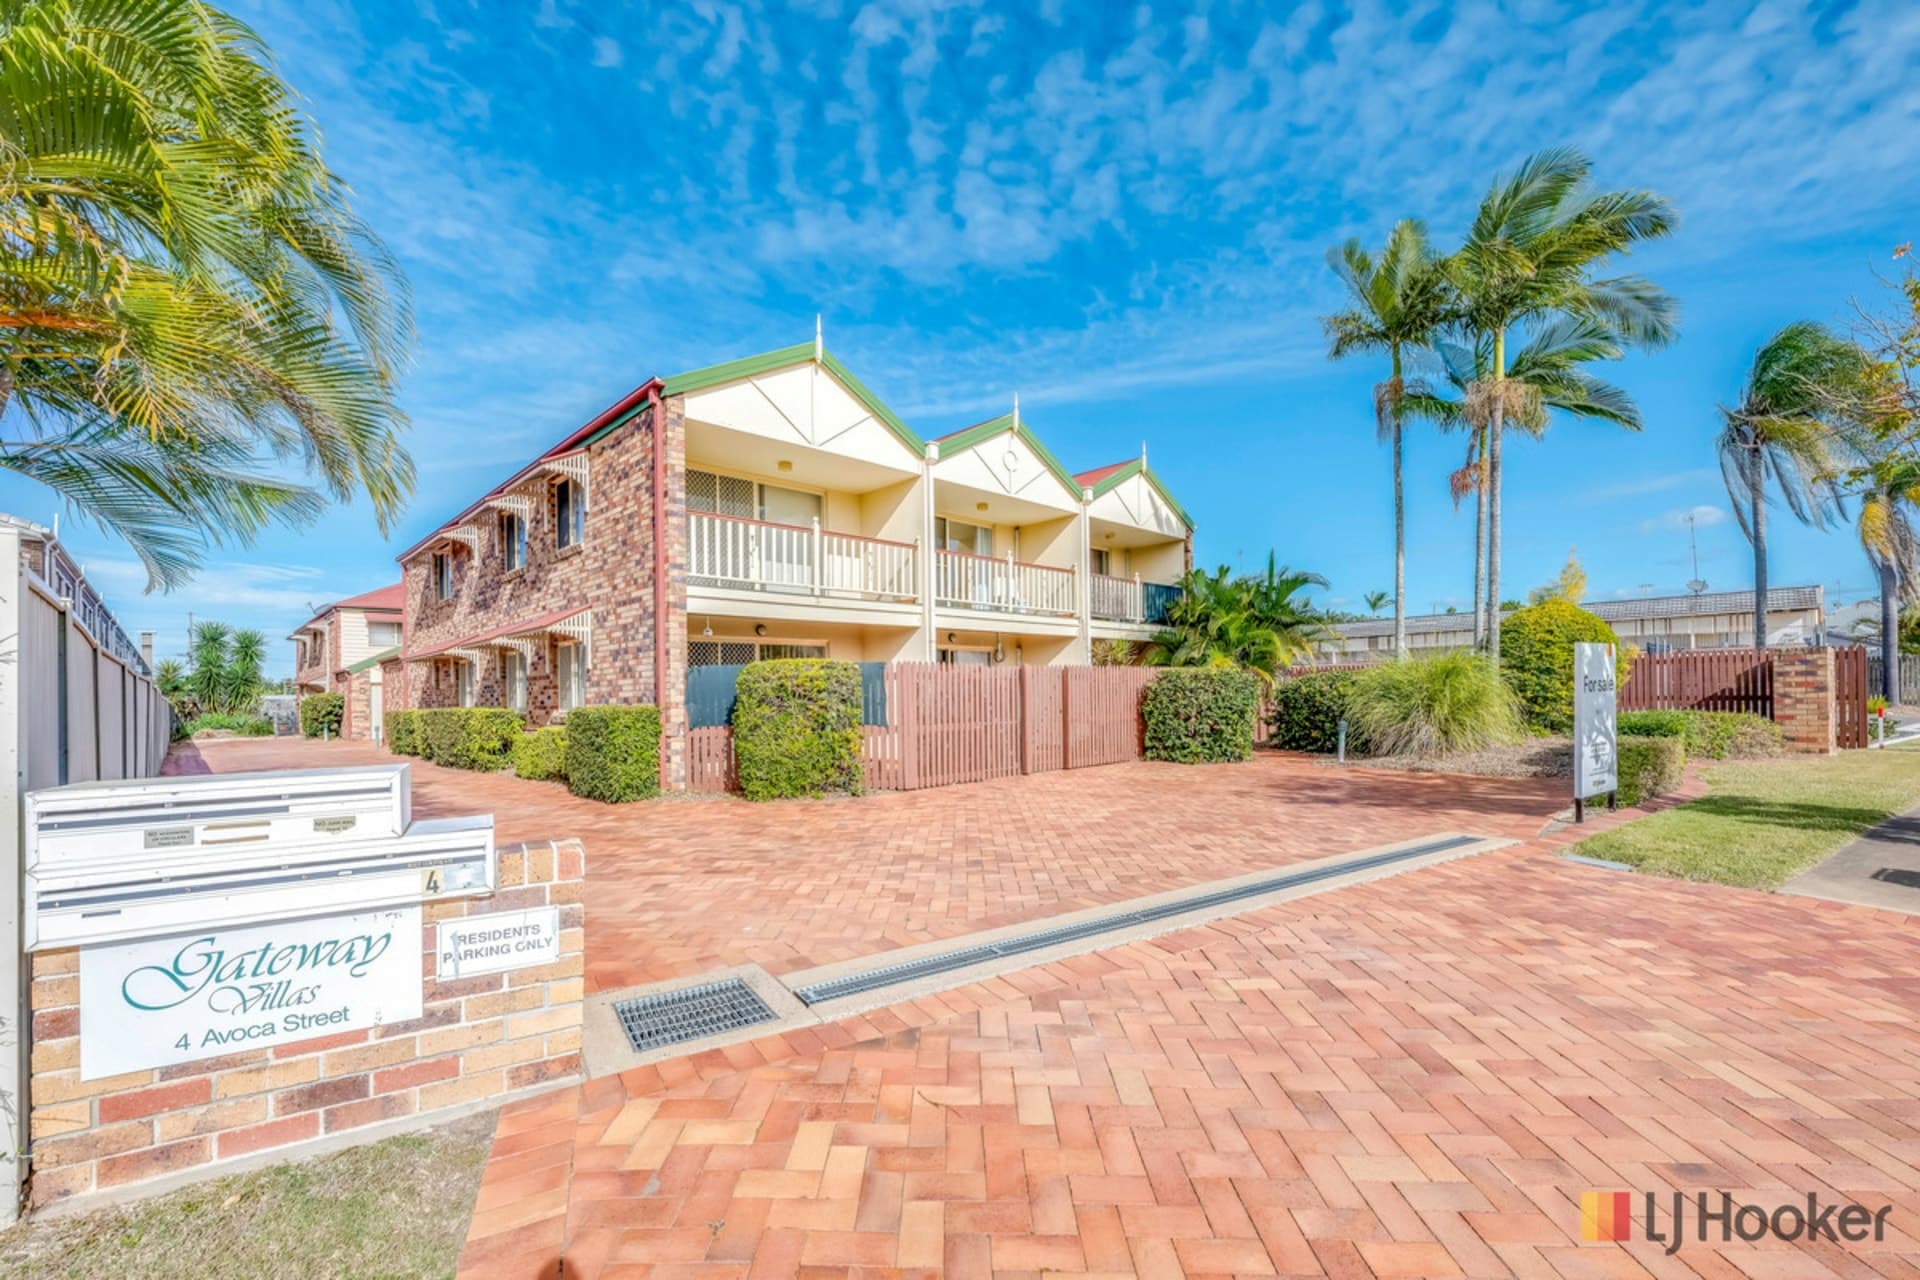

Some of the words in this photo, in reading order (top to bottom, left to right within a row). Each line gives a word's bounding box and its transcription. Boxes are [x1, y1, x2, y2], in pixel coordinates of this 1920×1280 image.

[426, 870, 440, 893] 4
[458, 924, 541, 946] RESIDENTS
[515, 937, 553, 952] ONLY
[122, 932, 392, 1010] Gateway
[208, 979, 322, 1016] Villas
[175, 1032, 191, 1051] 4
[201, 1021, 276, 1048] Avoca
[283, 1006, 350, 1033] Street
